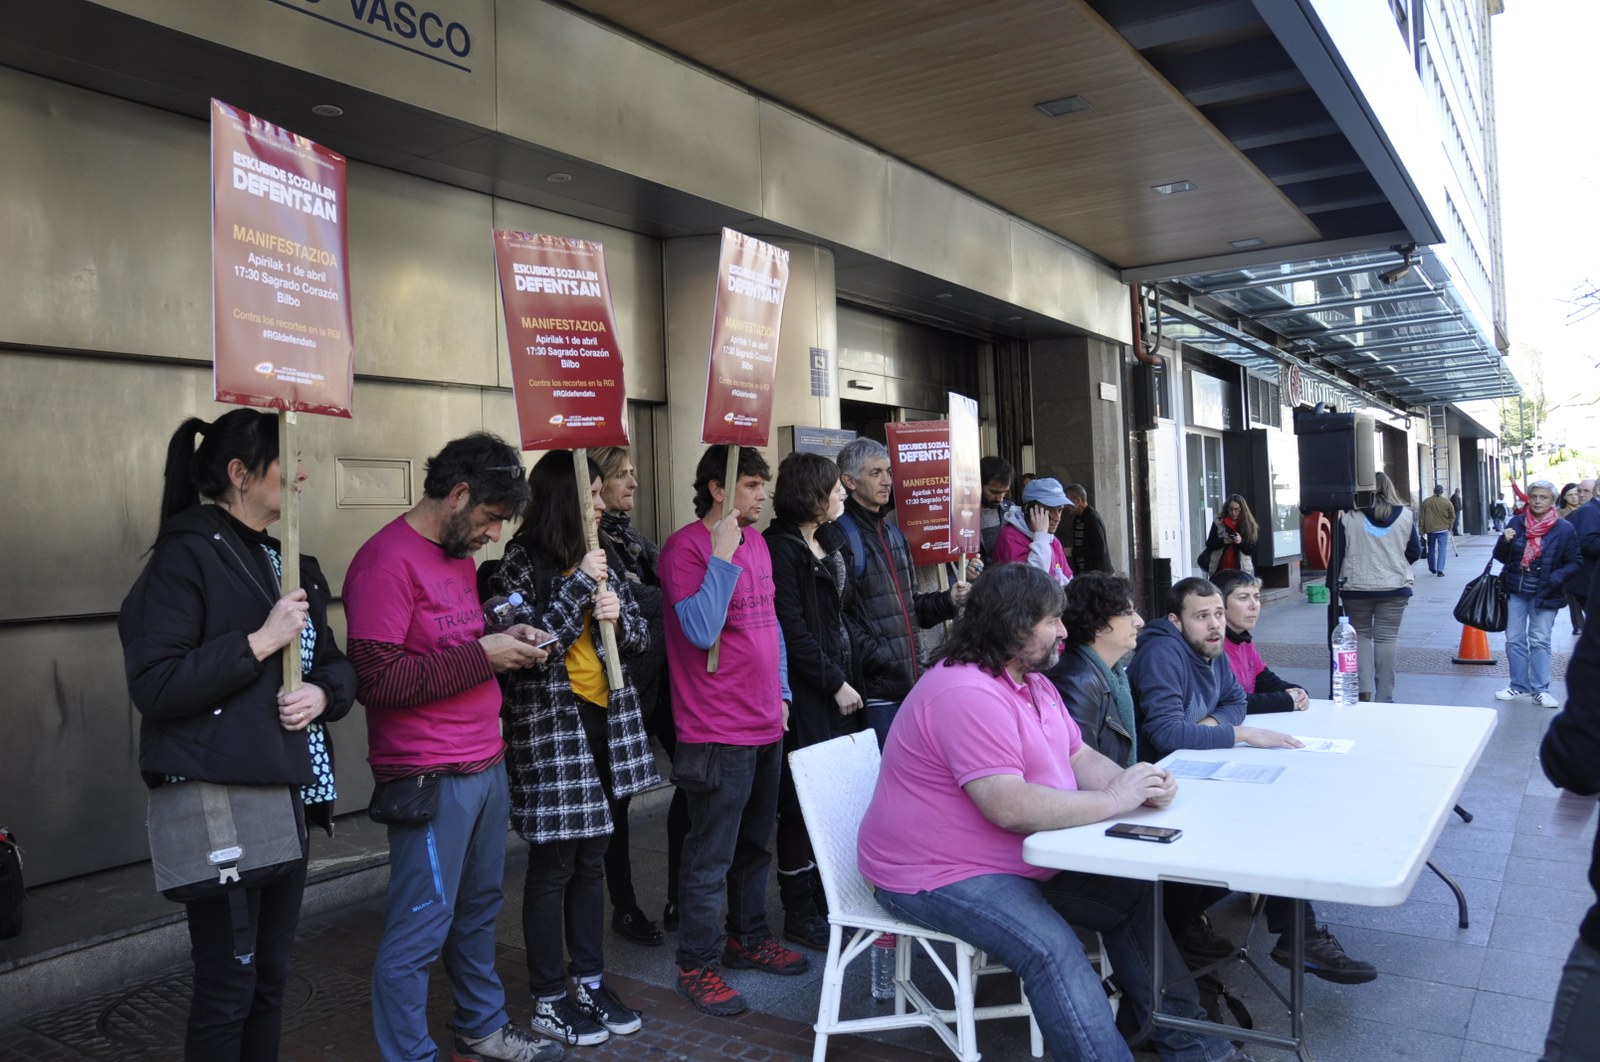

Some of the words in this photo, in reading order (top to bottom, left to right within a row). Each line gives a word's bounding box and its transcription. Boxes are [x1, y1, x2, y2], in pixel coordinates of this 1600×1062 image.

[350, 0, 471, 58] VASCO
[233, 151, 287, 182] ESKUBIDE
[287, 173, 336, 202] SOZIALEN
[233, 166, 337, 223] DEFENTSAN
[233, 224, 338, 268] MANIFESTAZIOA
[248, 252, 284, 272] Apirilak
[286, 264, 291, 273] 1
[293, 266, 305, 277] de
[306, 270, 326, 282] abril
[513, 263, 556, 277] ESKUBIDE
[556, 267, 599, 281] SOZIALEN
[233, 265, 260, 281] 17:30
[261, 272, 300, 291] Sagrado
[302, 283, 339, 301] Corazón
[514, 275, 602, 298] DEFENTSAN
[277, 291, 301, 307] Bilbo
[233, 308, 262, 323] Contra
[262, 315, 275, 326] los
[275, 319, 307, 333] recortes
[308, 326, 318, 335] en
[319, 327, 326, 337] la
[327, 328, 341, 339] RGI
[521, 317, 606, 333] MANIFESTAZIOA
[535, 334, 564, 345] Apirilak
[565, 336, 569, 344] 1
[571, 336, 581, 345] de
[581, 337, 598, 346] abril
[526, 346, 547, 356] 17:30
[547, 347, 579, 358] Sagrado
[579, 348, 610, 358] Corazón
[560, 359, 580, 369] Bilbo
[528, 378, 551, 387] Contra
[551, 379, 561, 387] los
[562, 379, 587, 387] recortes
[596, 379, 603, 387] la
[603, 379, 615, 387] RGI
[730, 593, 775, 611] RAGAM
[1344, 652, 1357, 662] NO
